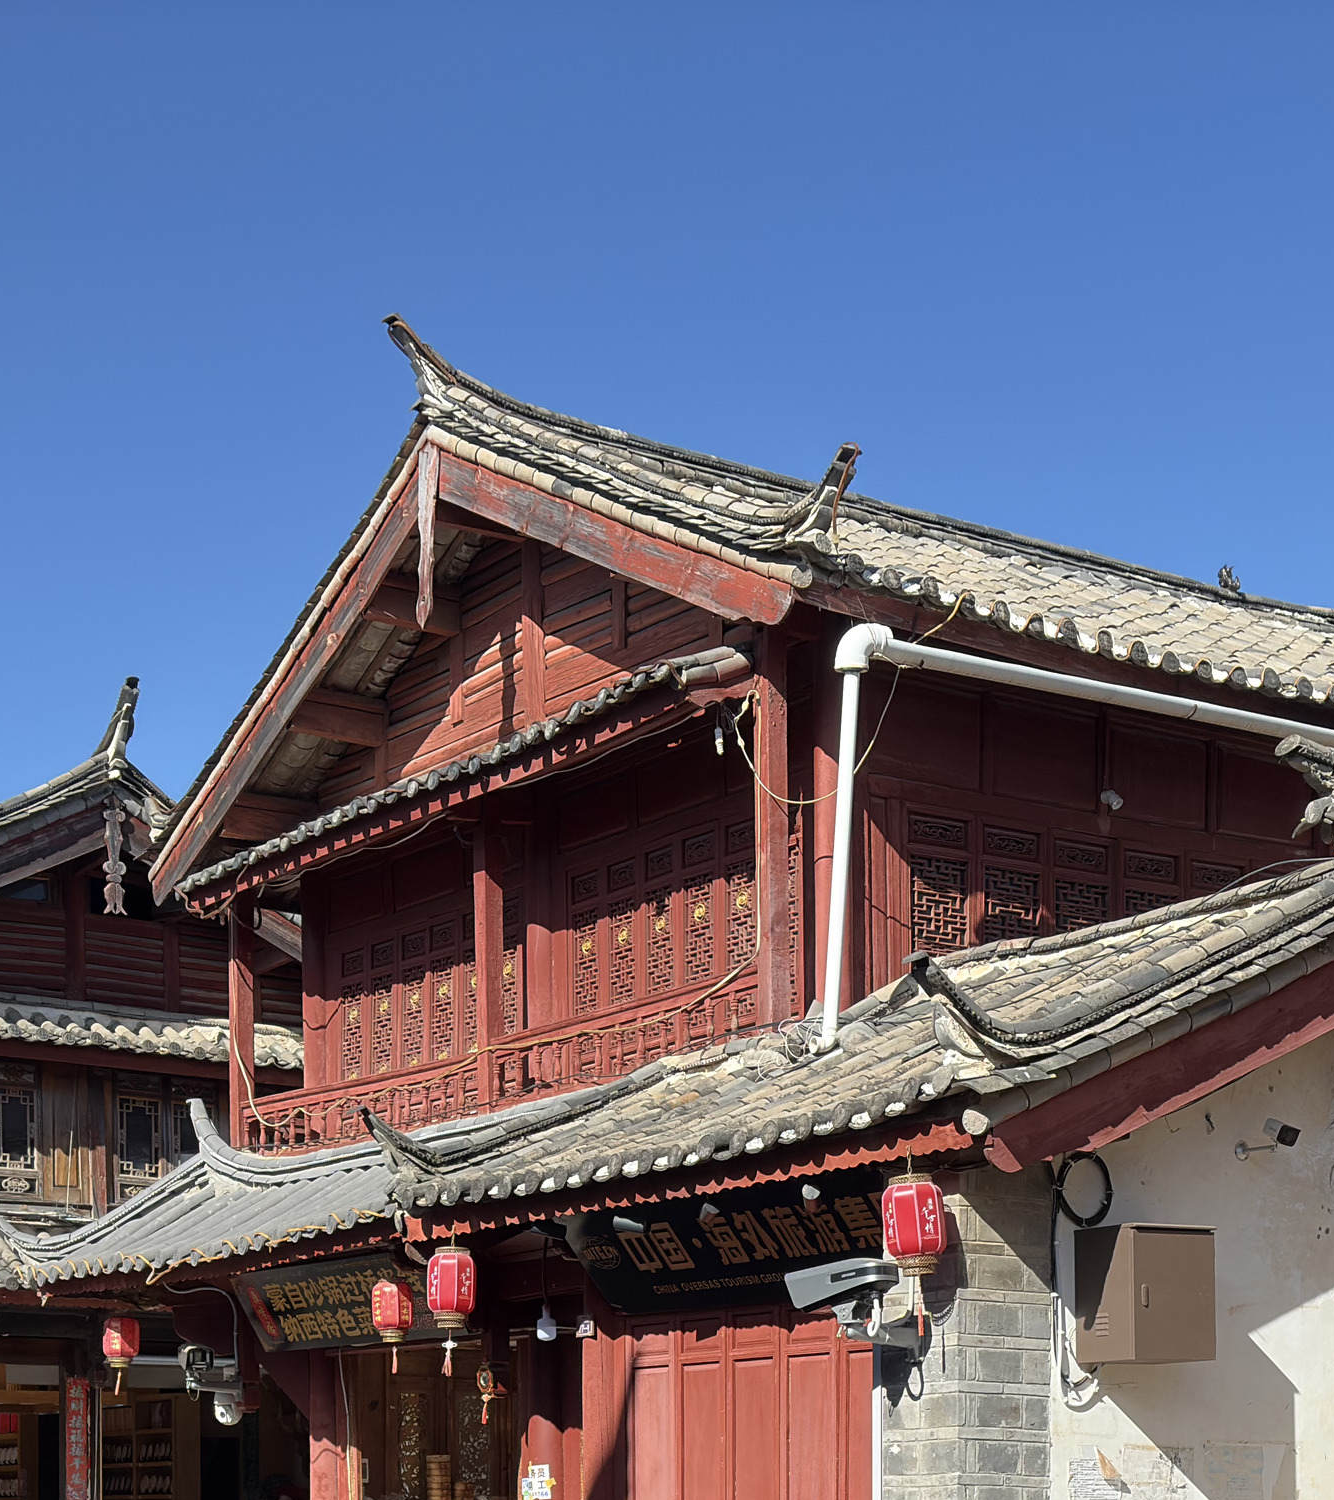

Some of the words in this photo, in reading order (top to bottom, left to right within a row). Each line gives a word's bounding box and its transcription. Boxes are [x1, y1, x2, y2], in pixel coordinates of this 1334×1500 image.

[652, 1283, 680, 1296] CHINA
[721, 1275, 760, 1289] TOURISM
[760, 1272, 787, 1284] GROU
